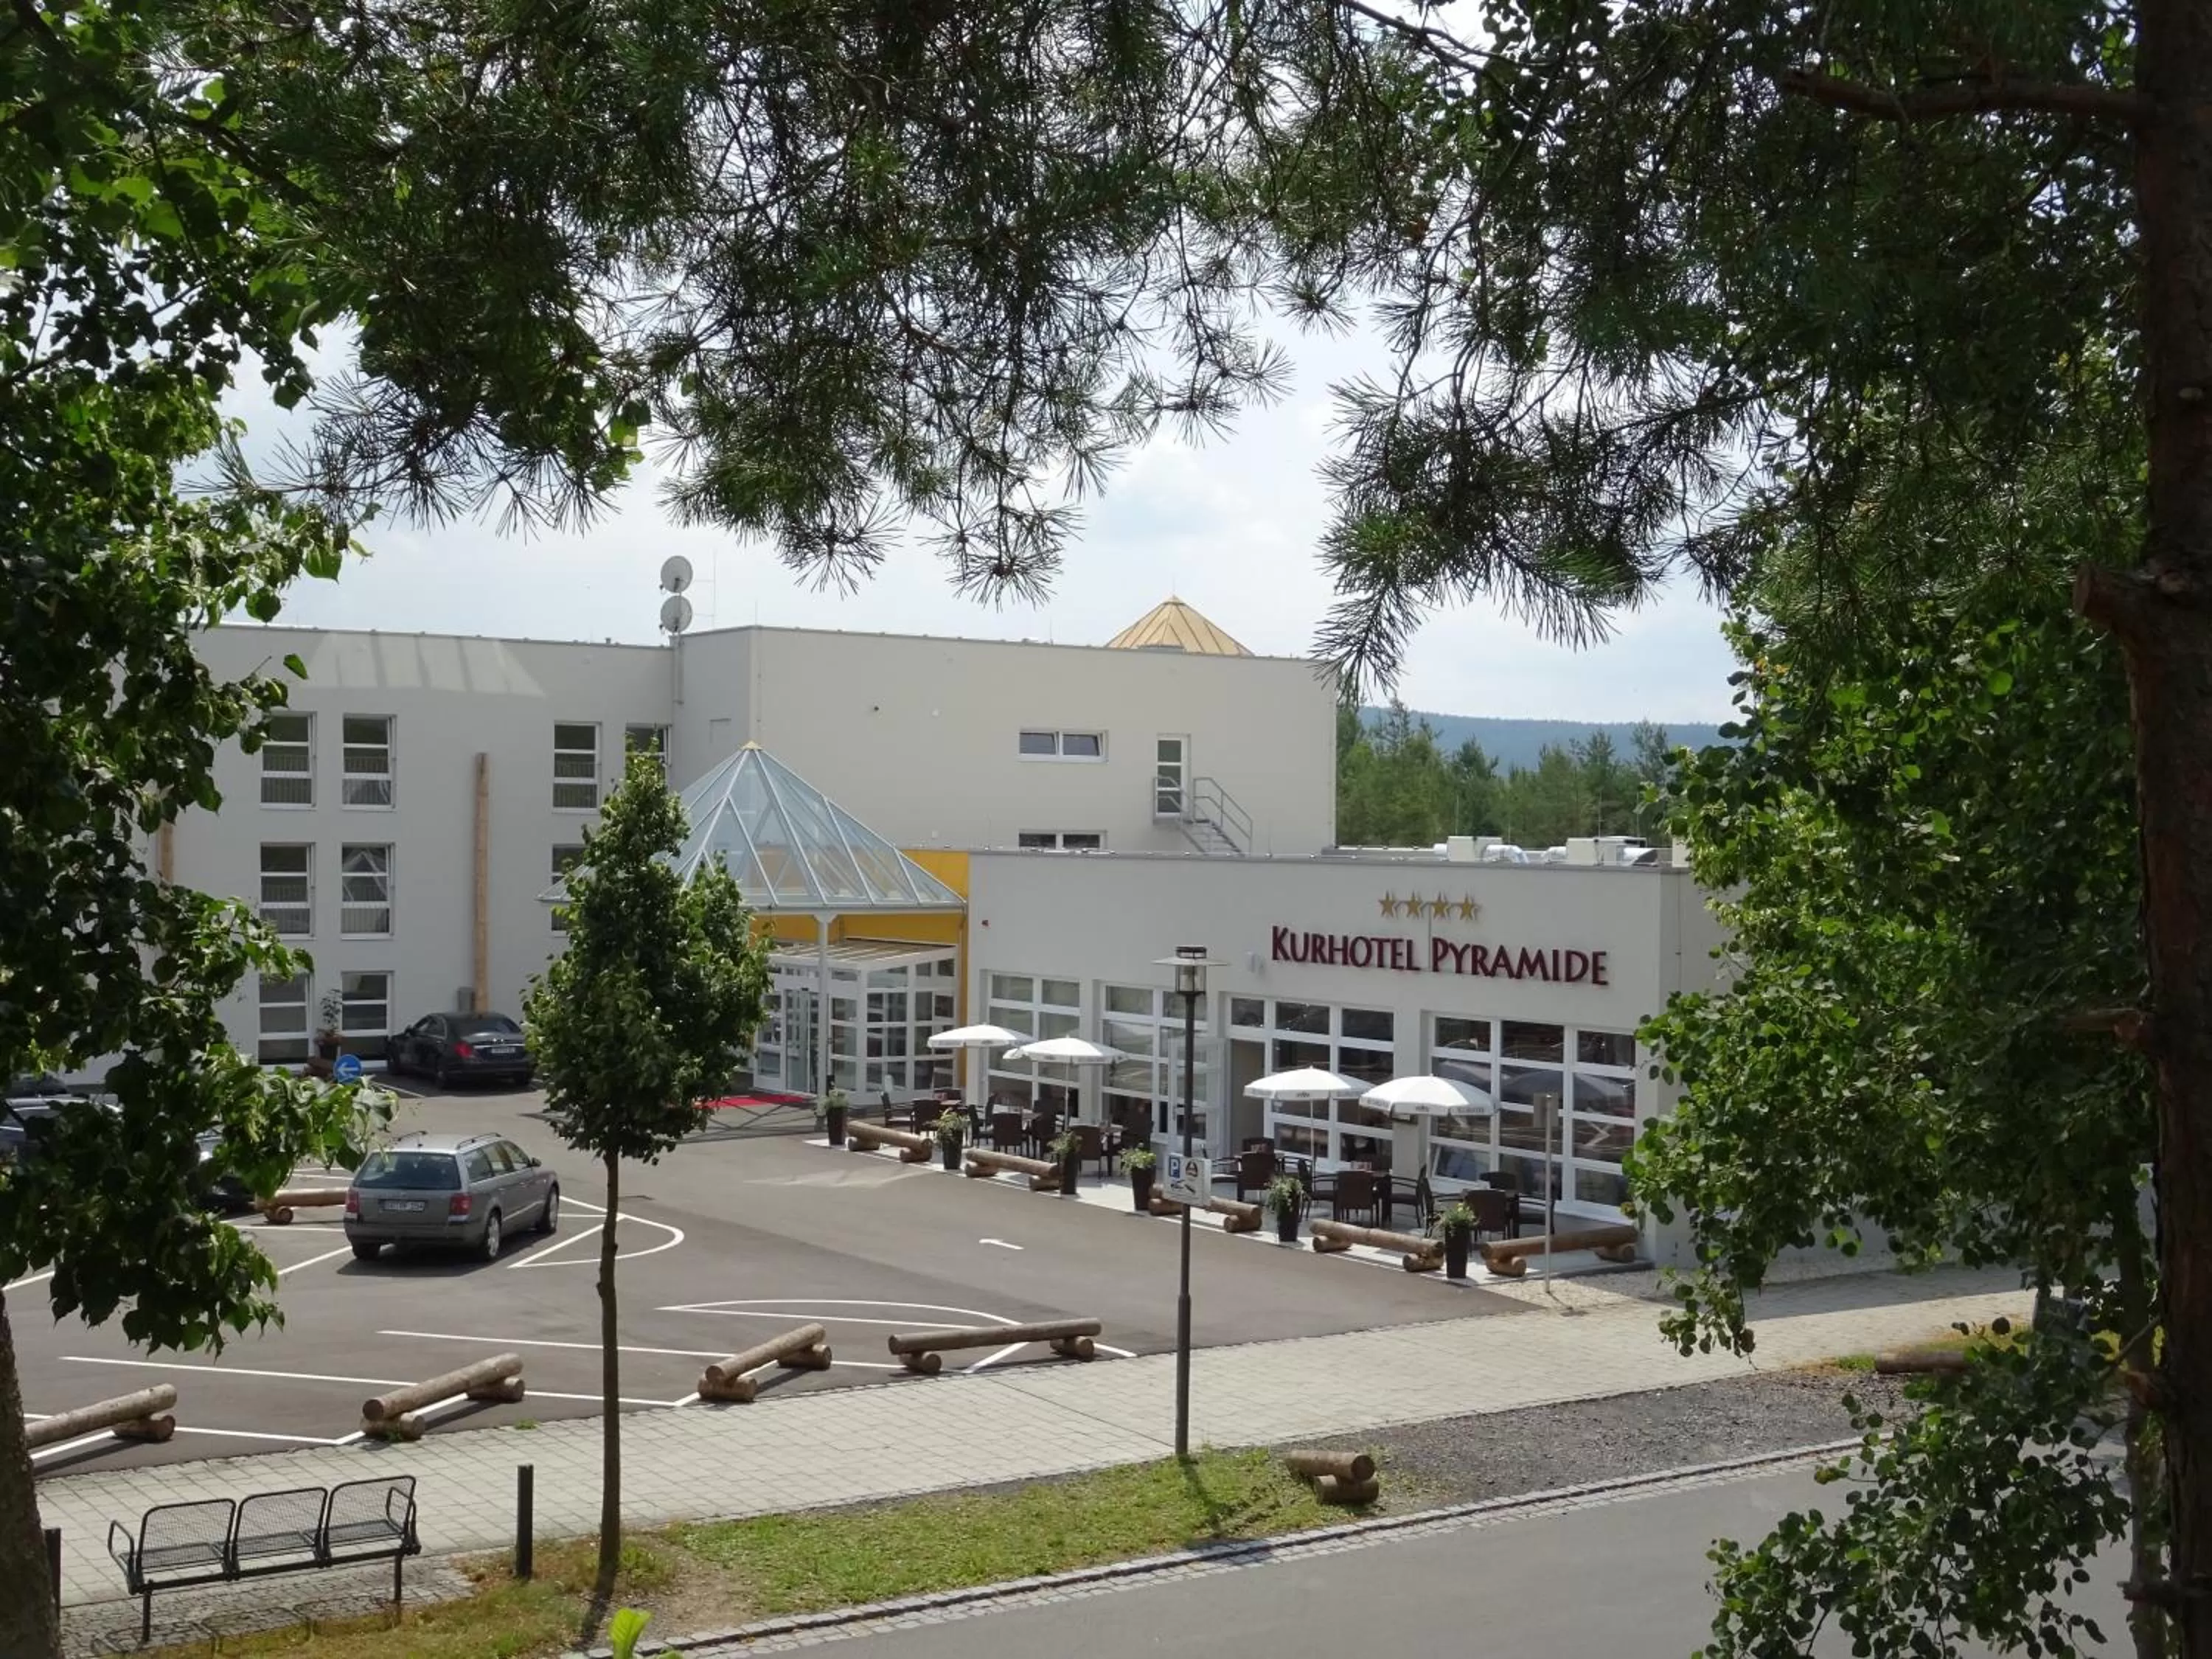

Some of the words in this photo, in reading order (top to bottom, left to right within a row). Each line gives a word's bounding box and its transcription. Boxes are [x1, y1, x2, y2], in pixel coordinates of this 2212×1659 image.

[1271, 925, 1420, 971] KURHOTEL
[1432, 936, 1609, 985] PYRAMIDE
[1170, 1158, 1180, 1177] P
